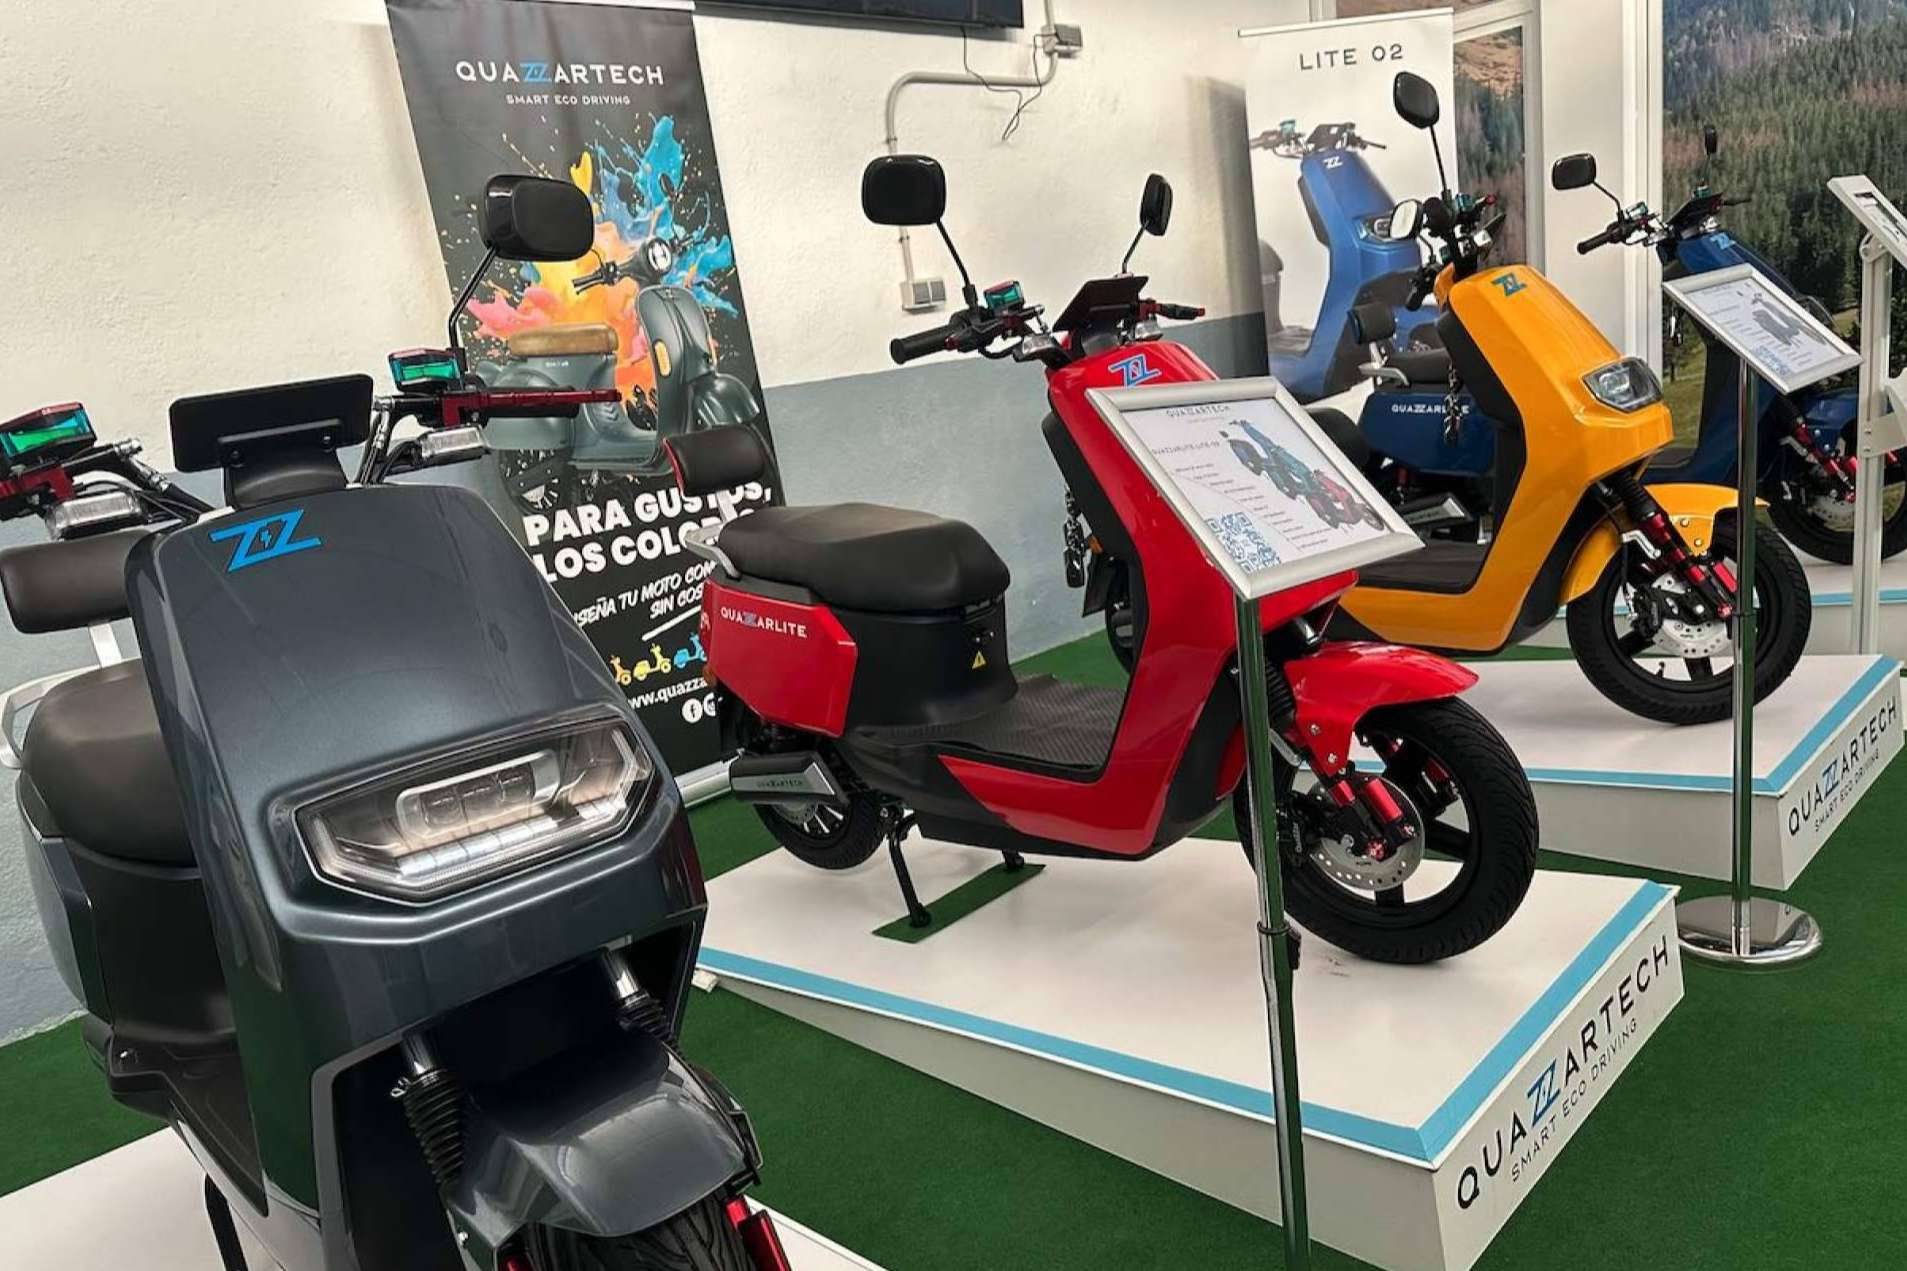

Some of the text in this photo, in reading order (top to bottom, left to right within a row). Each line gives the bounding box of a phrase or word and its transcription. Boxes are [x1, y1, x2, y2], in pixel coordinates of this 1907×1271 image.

[456, 59, 665, 86] QUAZZARTECH
[1299, 48, 1357, 70] LITE
[506, 94, 631, 105] SMART ECO DRIVING
[1391, 403, 1470, 415] QUAZZARLE
[522, 498, 632, 547] PARA
[532, 541, 607, 583] LOS
[573, 597, 618, 630] ISEÑA
[618, 589, 639, 610] TU
[640, 573, 682, 602] MOTO
[650, 594, 674, 619] SIN
[1787, 695, 1897, 836] QUAZZARTECH
[1457, 935, 1669, 1210] QUAZZARTECH
[1511, 1017, 1638, 1183] SMART ECO DRIVING
